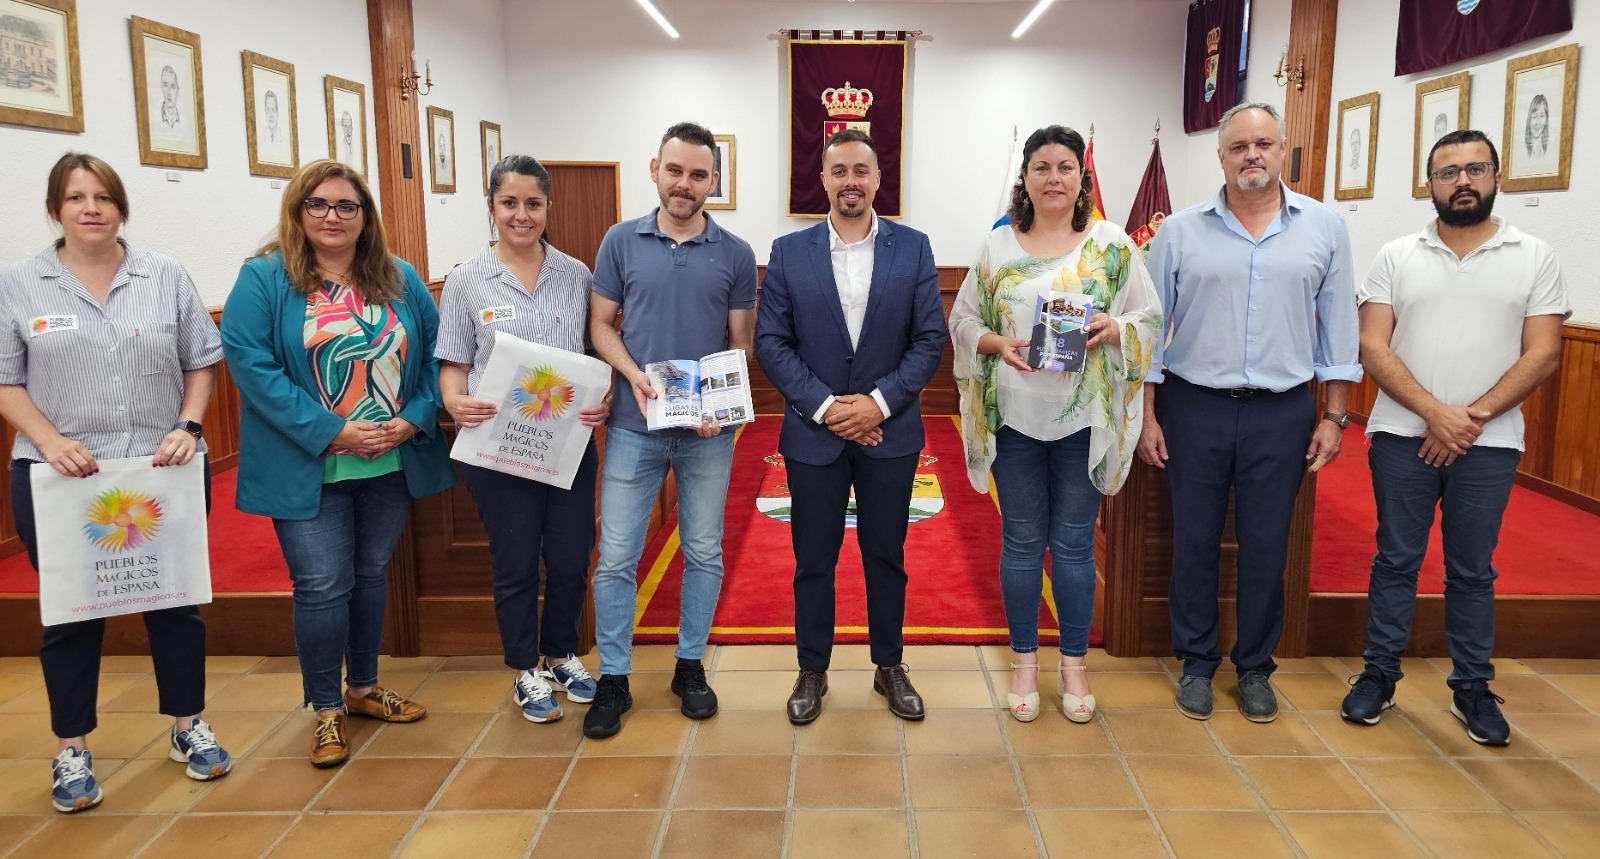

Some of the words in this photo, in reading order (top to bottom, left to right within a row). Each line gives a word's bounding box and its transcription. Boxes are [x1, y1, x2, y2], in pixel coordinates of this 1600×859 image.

[508, 420, 554, 439] PUEBLOS
[510, 446, 544, 462] ESPAÑA
[95, 554, 158, 571] PUEBLOS
[95, 567, 159, 585] MÁGICOS
[97, 589, 110, 598] DE
[114, 581, 160, 595] ESPAÑA
[71, 591, 187, 613] www.pueblosmagicos.es
